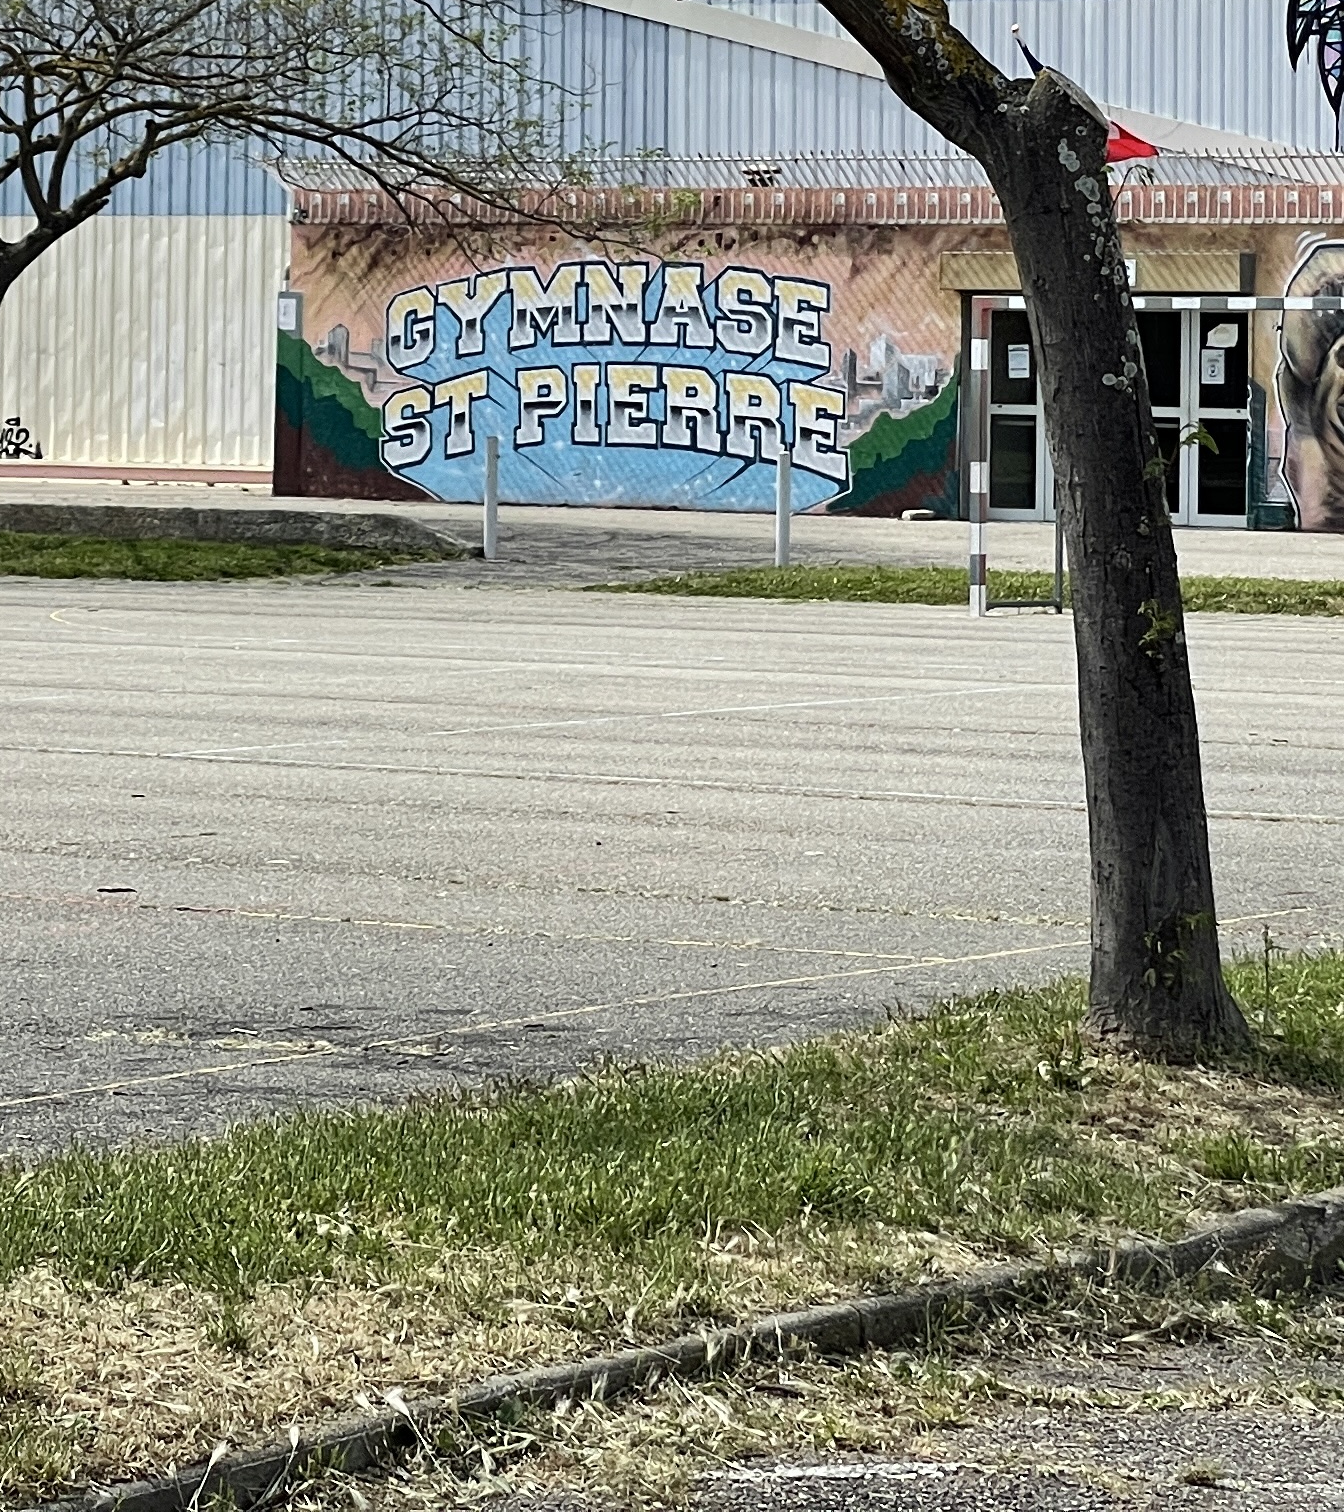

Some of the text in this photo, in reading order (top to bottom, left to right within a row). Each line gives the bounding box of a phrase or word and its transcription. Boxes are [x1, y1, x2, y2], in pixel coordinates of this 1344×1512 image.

[386, 261, 831, 374] GYMNASE
[380, 362, 851, 486] ST PIERRE
